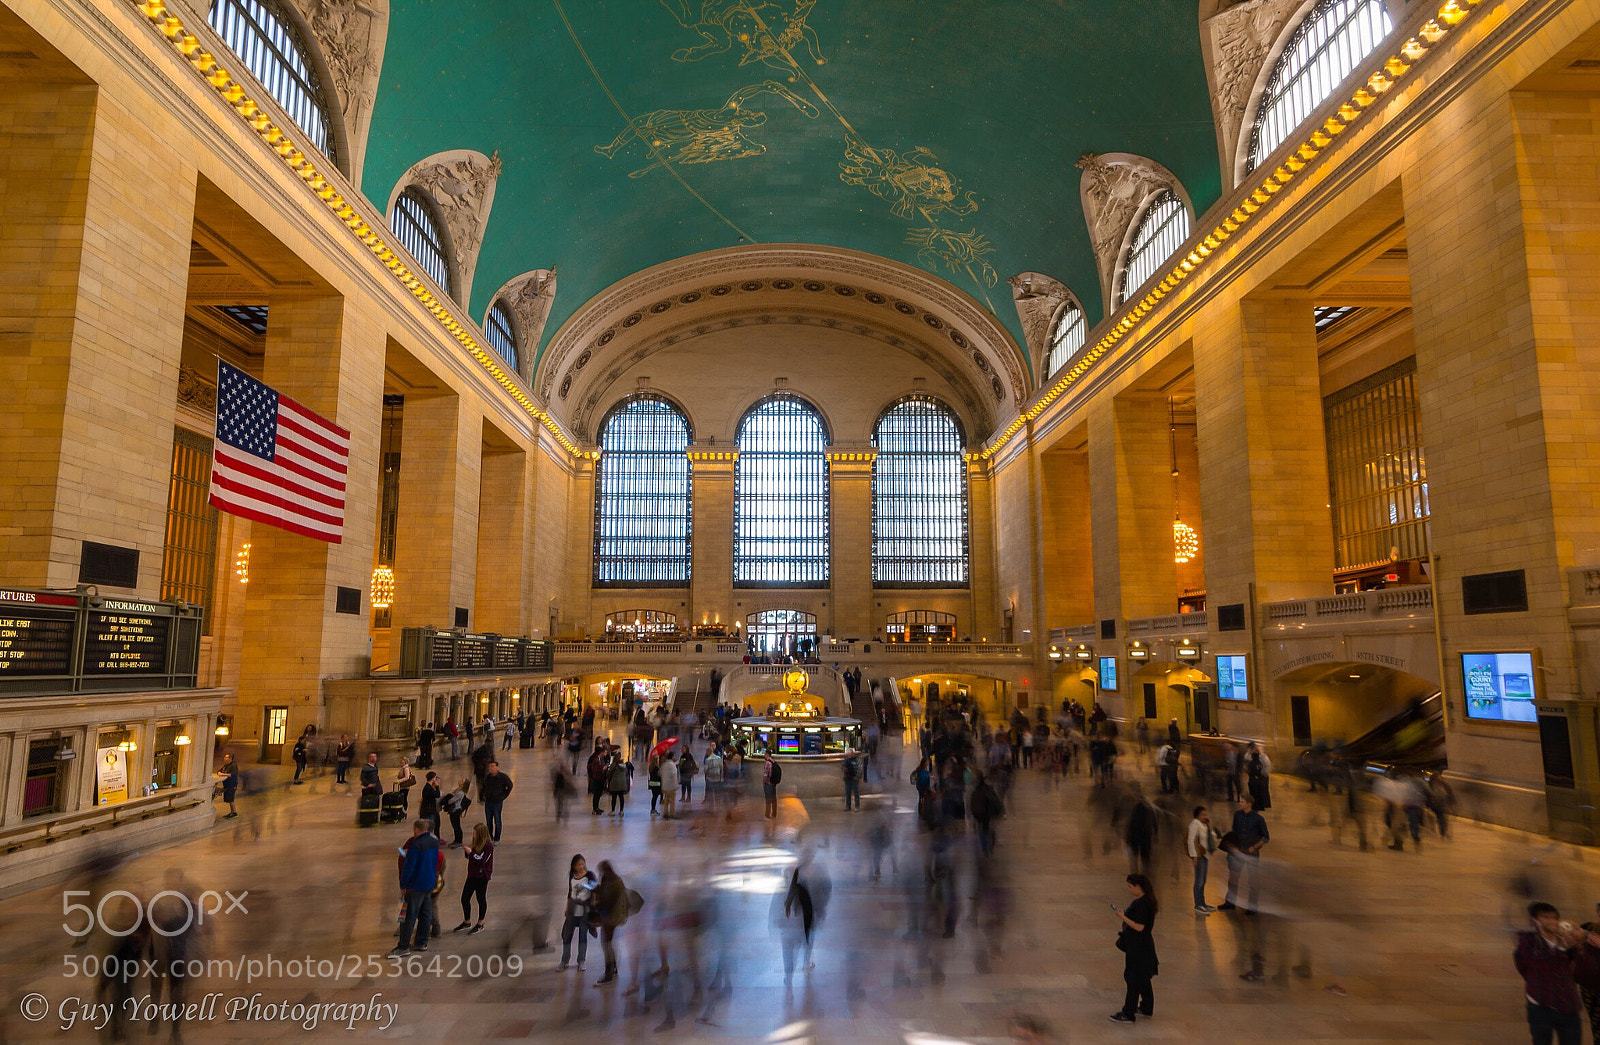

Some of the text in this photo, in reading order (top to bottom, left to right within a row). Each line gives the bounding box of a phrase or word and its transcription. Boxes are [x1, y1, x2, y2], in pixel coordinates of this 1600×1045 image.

[0, 591, 36, 602] RTURES
[105, 600, 156, 612] INFORMATION
[16, 620, 31, 628] EAST
[1, 630, 19, 638] CONV.
[9, 651, 25, 659] STOP
[1375, 653, 1406, 667] STREET
